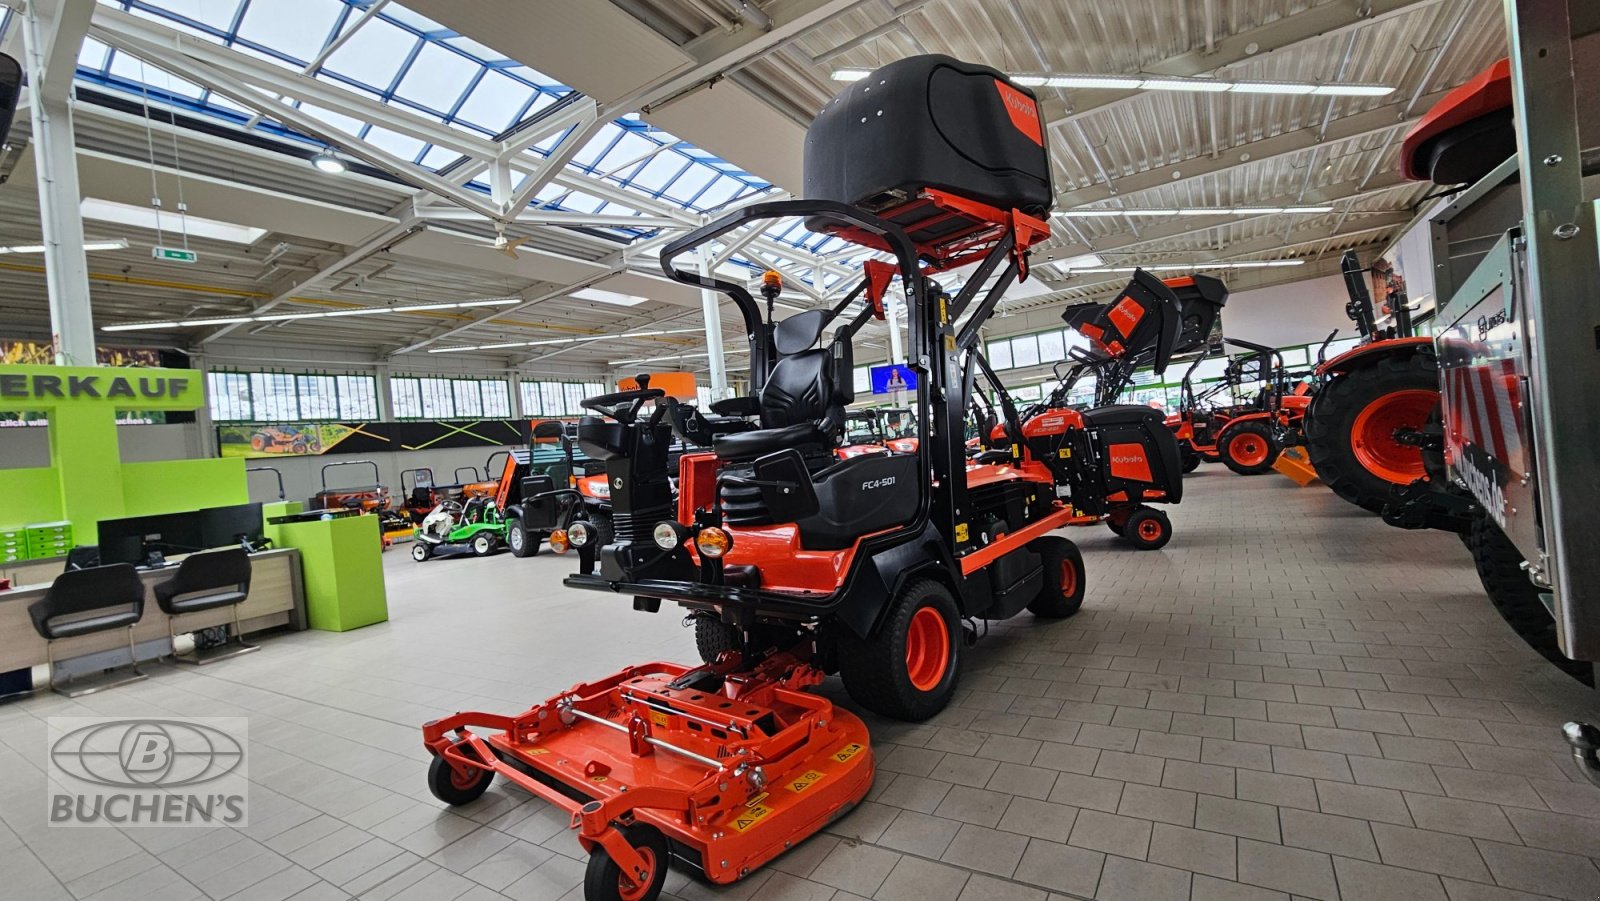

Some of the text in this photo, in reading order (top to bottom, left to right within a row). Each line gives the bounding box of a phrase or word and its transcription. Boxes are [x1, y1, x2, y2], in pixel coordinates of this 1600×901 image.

[1005, 90, 1036, 119] Kubota
[1118, 304, 1136, 322] Kubota
[0, 374, 189, 398] ERKAUF
[1112, 456, 1143, 464] Kubota
[862, 476, 896, 491] FC4-501
